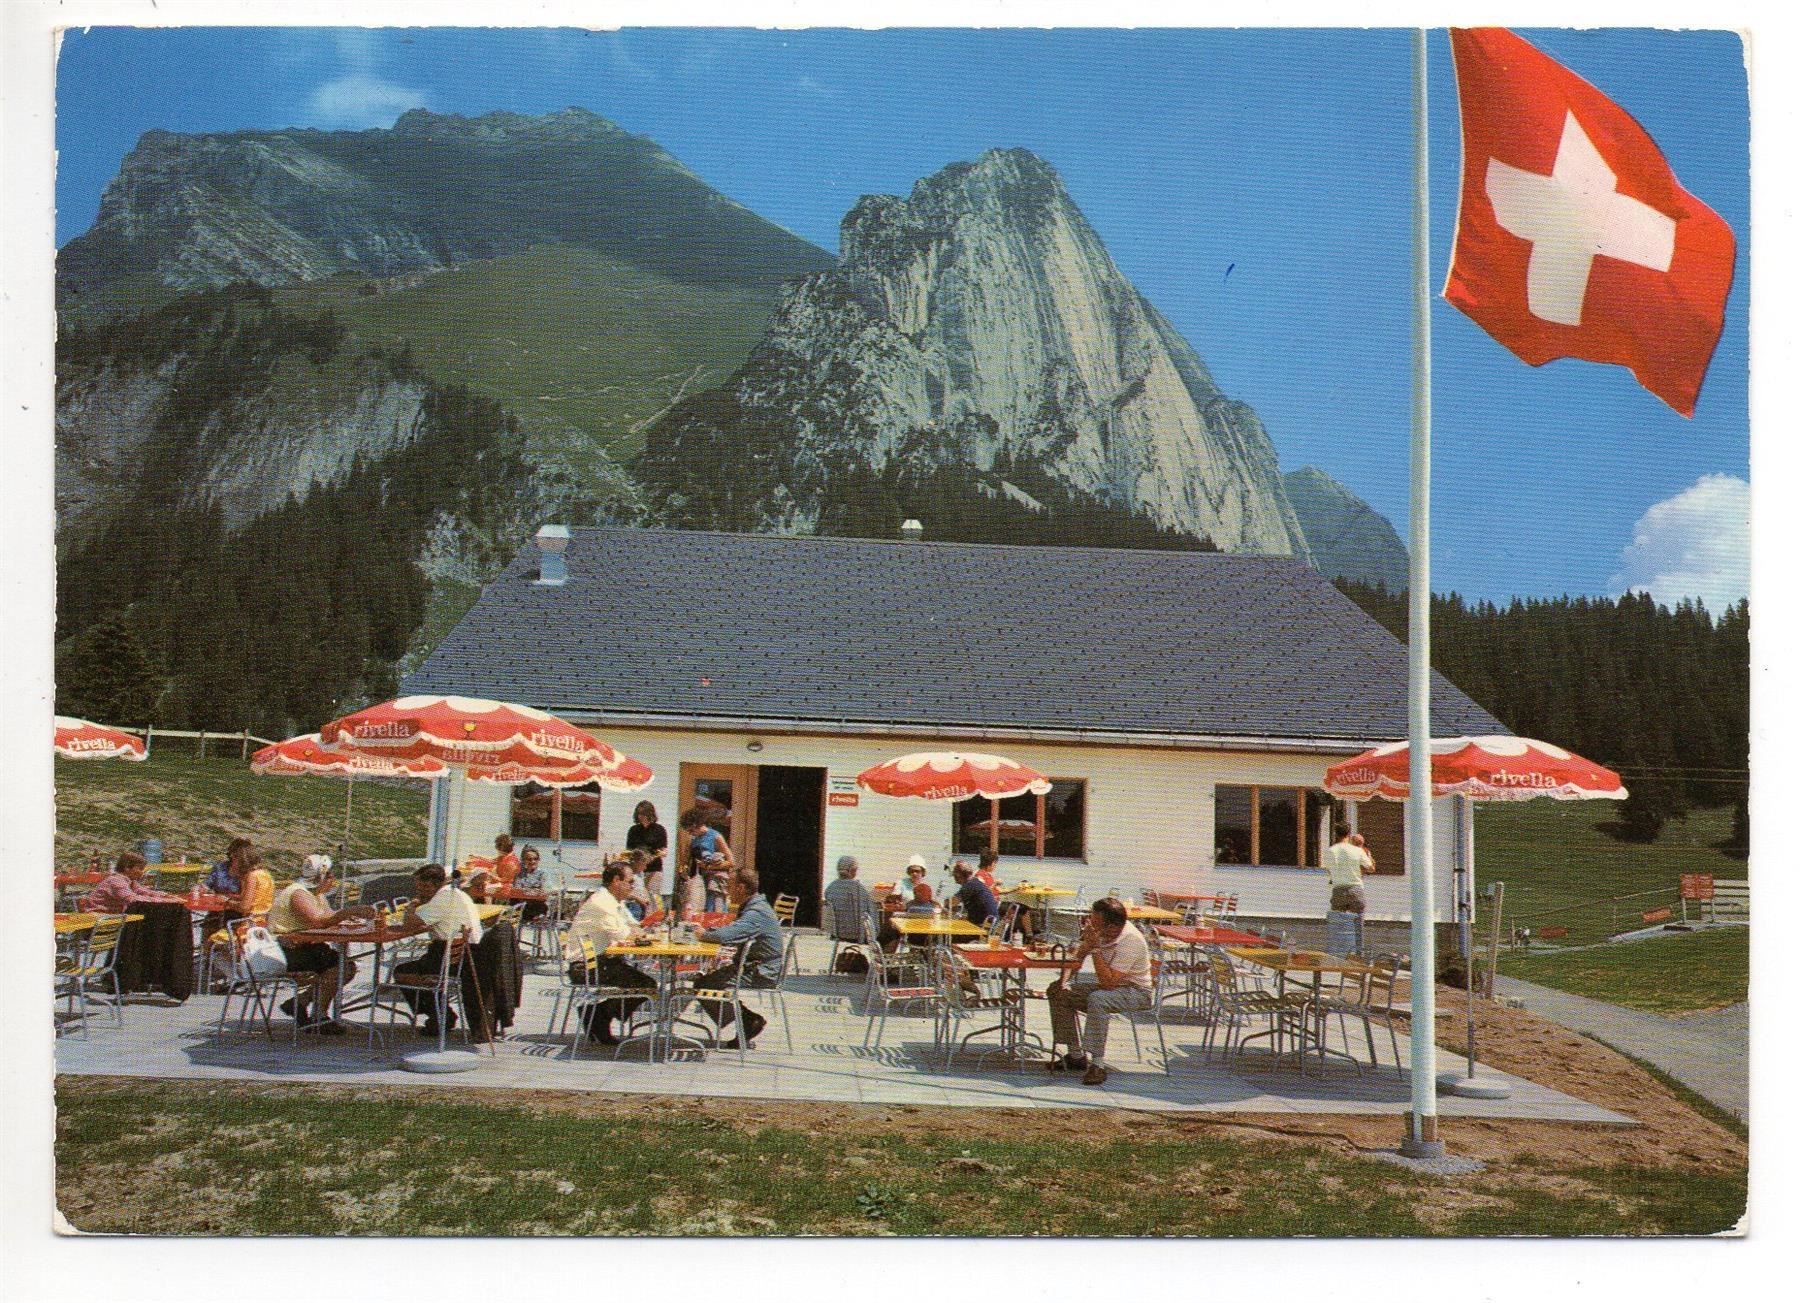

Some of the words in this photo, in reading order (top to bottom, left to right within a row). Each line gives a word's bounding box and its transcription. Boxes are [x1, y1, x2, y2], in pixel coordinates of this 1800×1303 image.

[352, 719, 410, 738] rivella
[67, 736, 117, 752] rivella
[530, 729, 585, 753] rivella
[349, 755, 394, 771] rivella
[1335, 767, 1377, 785] rivella
[1490, 768, 1558, 788] rivella
[922, 784, 968, 800] rivella
